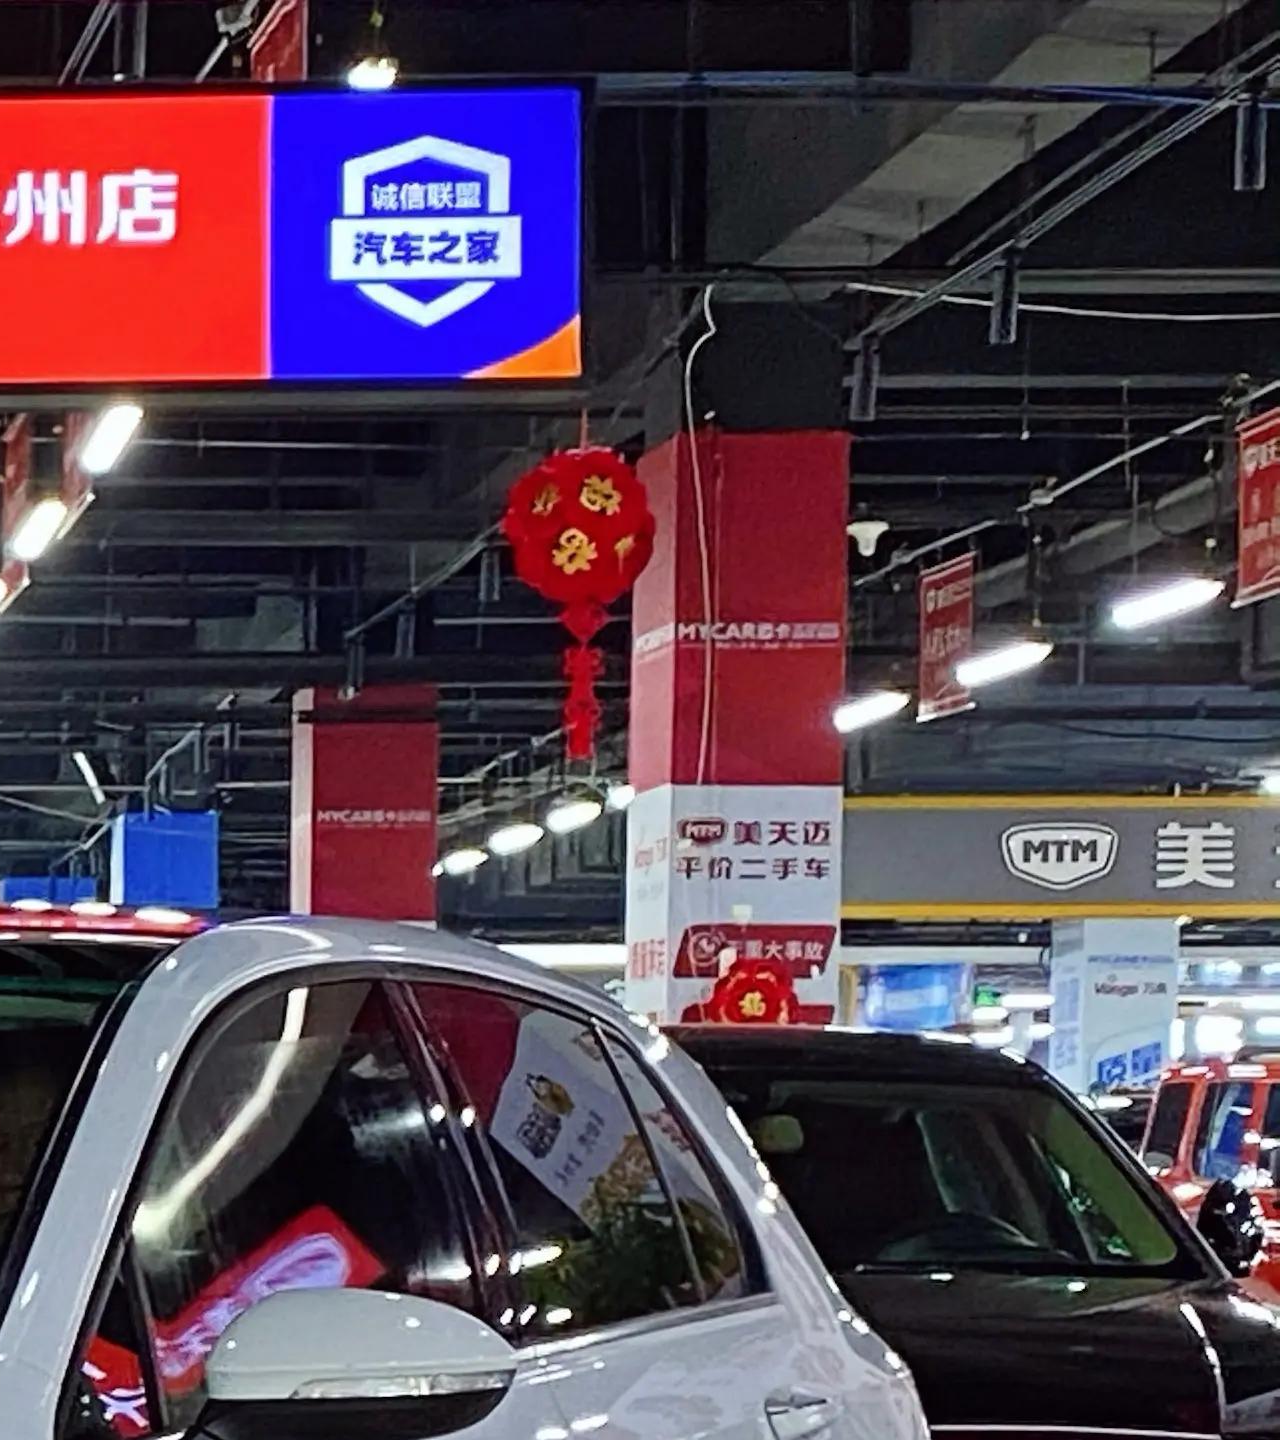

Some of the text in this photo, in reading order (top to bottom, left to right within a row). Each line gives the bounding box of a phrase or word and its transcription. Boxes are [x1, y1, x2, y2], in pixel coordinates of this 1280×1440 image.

[370, 181, 483, 212] 诚信联盟
[351, 230, 501, 266] 汽车之家
[733, 820, 831, 847] 美天迈
[1022, 838, 1098, 863] MTM
[676, 855, 831, 881] 平价二手车
